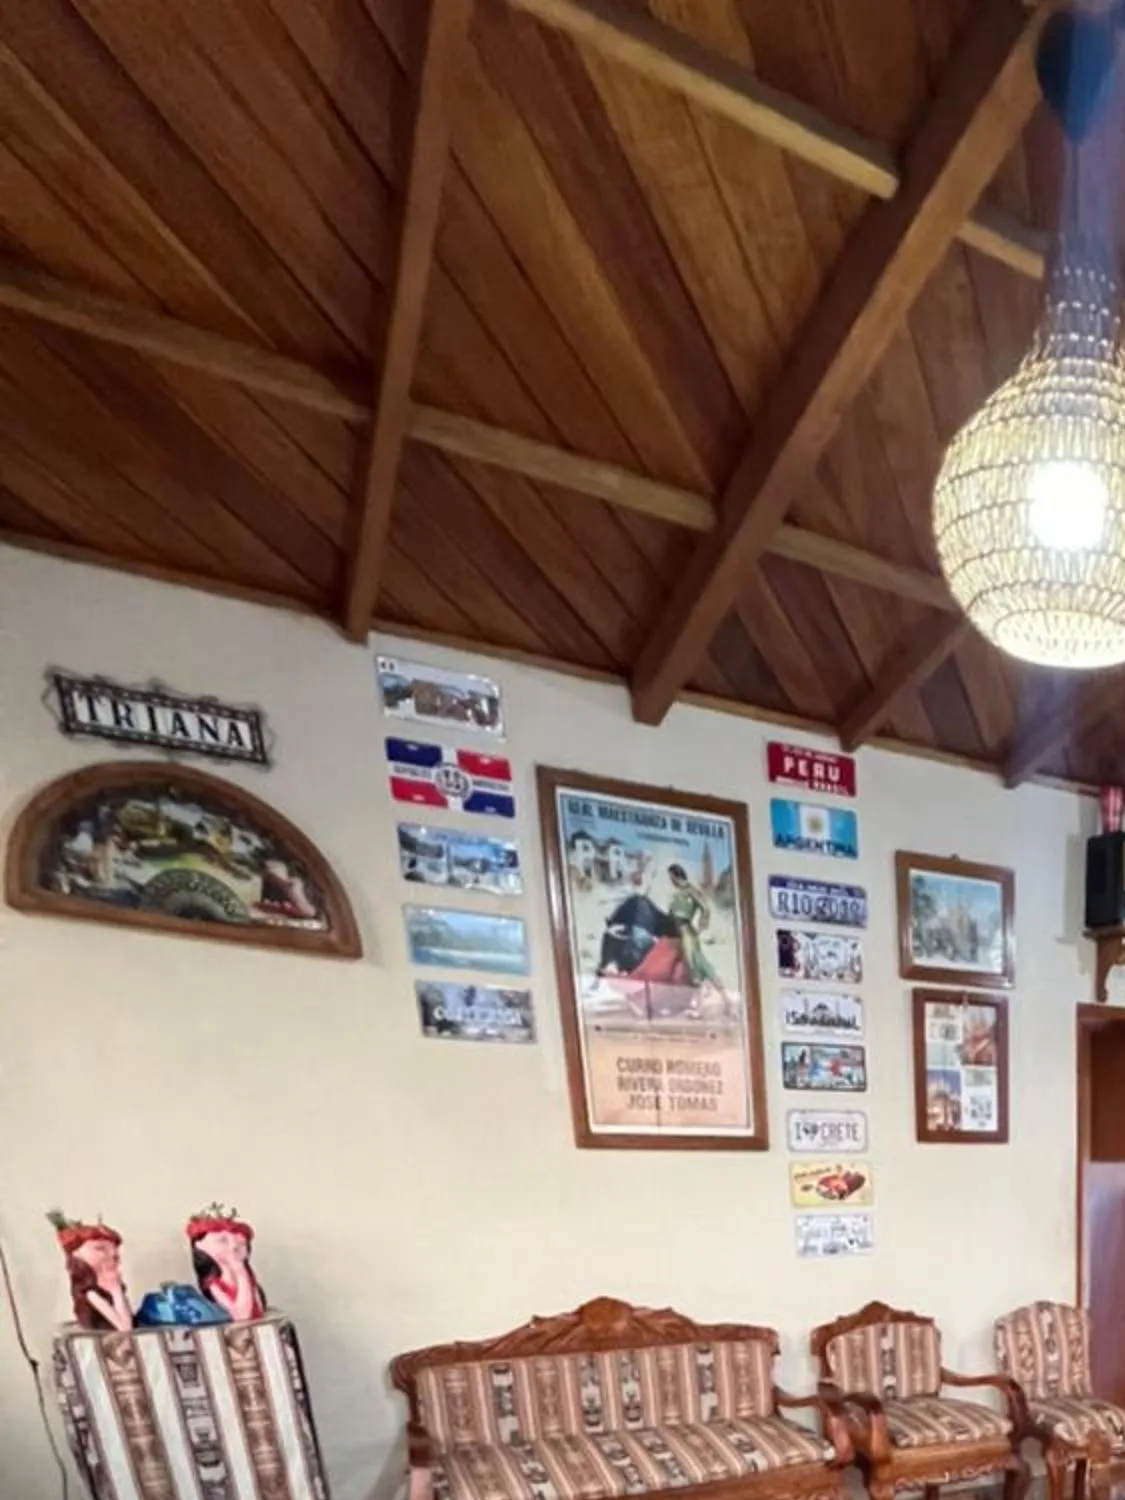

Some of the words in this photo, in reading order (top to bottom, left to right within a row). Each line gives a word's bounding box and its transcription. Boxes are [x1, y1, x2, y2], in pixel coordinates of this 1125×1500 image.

[77, 691, 244, 748] TRIANA
[783, 756, 841, 783] PERU
[820, 1122, 860, 1141] CRETE
